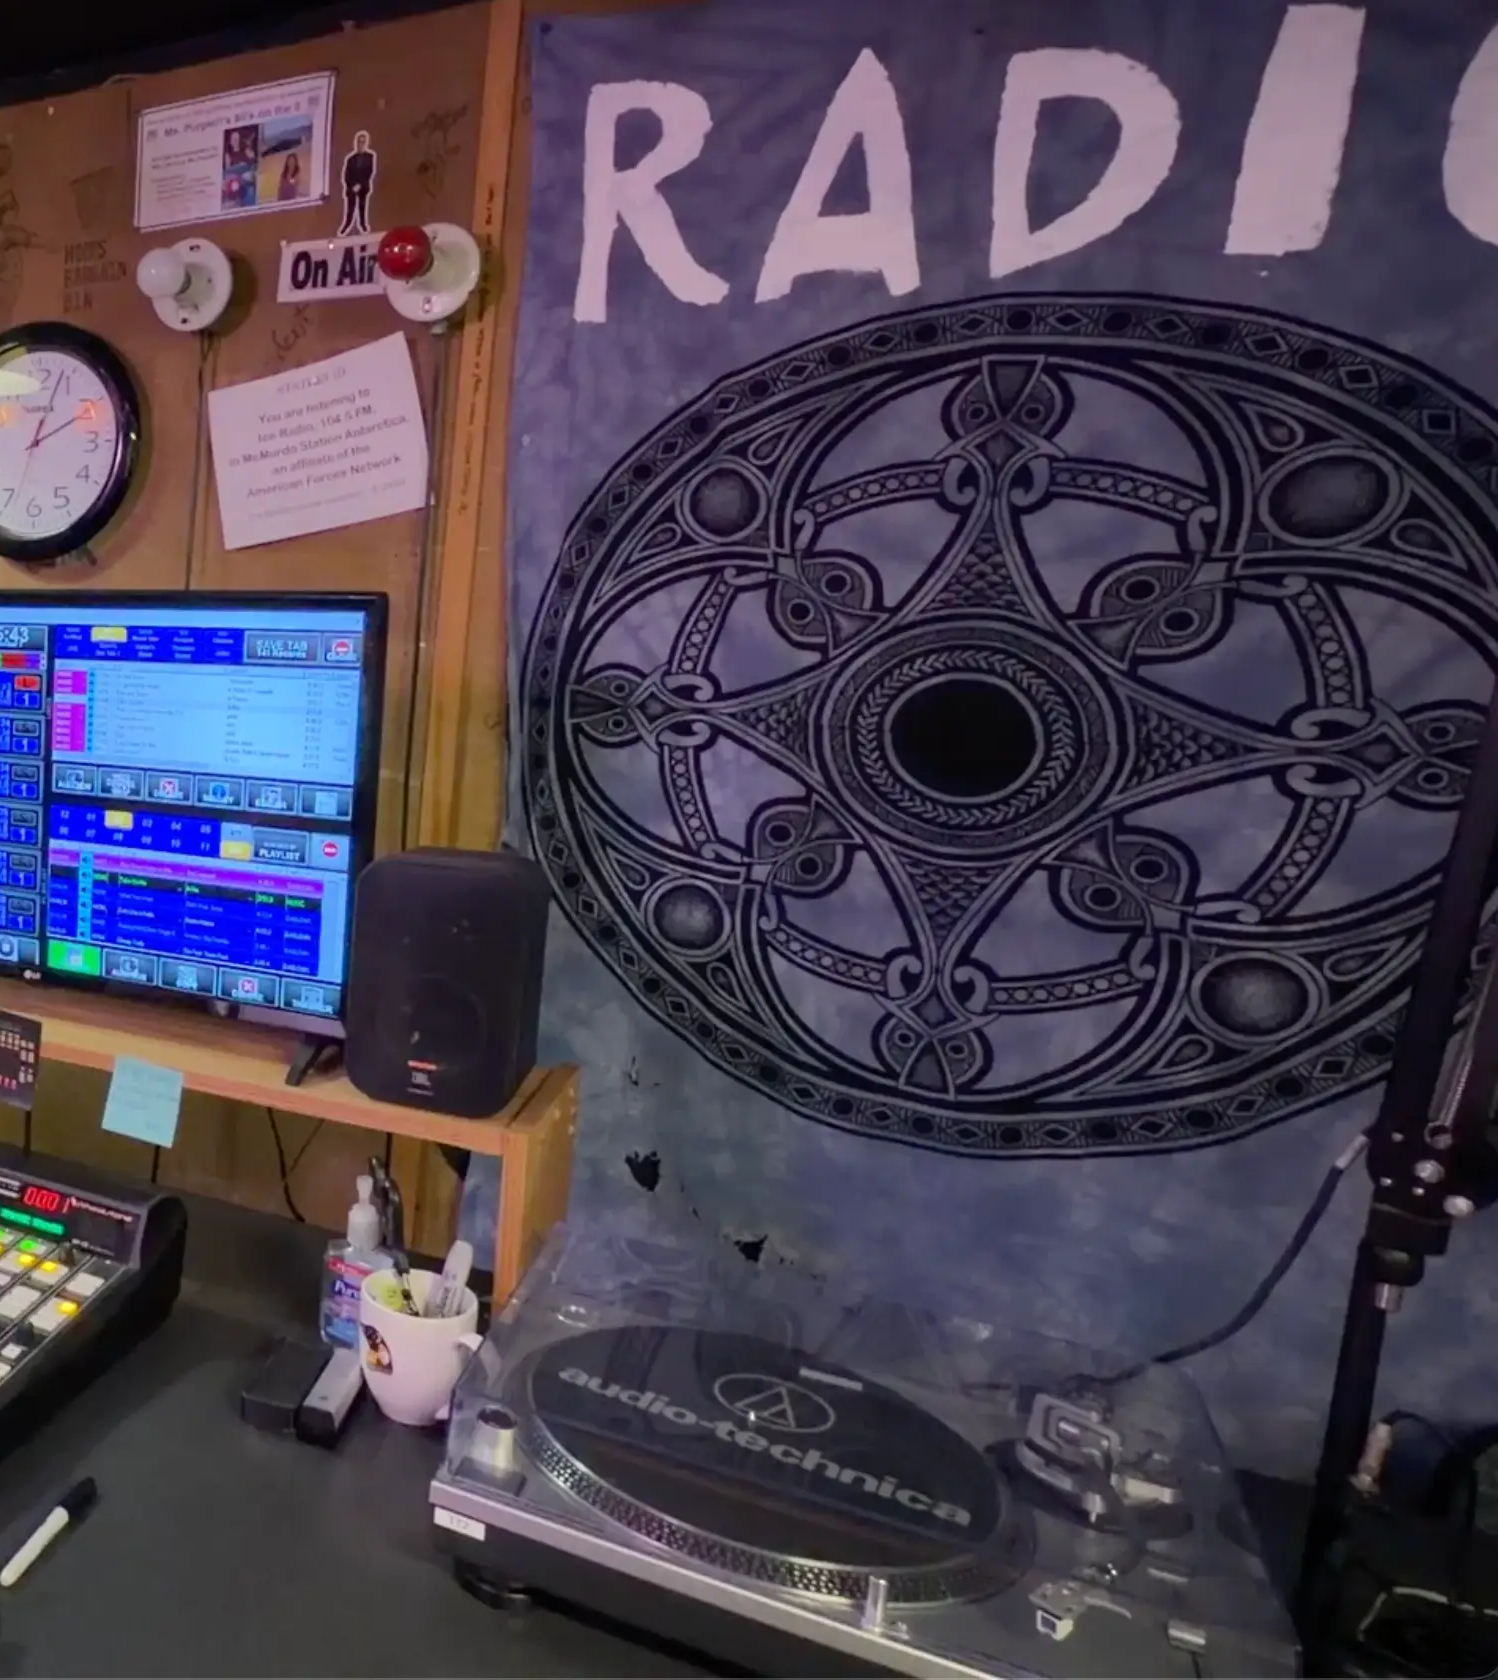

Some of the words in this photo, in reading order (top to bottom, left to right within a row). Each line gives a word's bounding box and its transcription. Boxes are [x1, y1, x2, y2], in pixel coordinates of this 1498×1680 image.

[290, 249, 329, 291] On
[335, 244, 379, 287] Air
[65, 374, 71, 397] 1
[258, 412, 282, 425] You
[284, 407, 303, 420] are
[306, 393, 356, 415] listening
[359, 388, 370, 398] to
[84, 431, 99, 454] 3
[229, 456, 240, 467] in
[242, 446, 297, 464] McMurdo
[300, 436, 343, 452] Station
[271, 466, 287, 476] an
[336, 450, 349, 461] of
[350, 444, 370, 457] the
[76, 465, 90, 483] 4
[246, 480, 303, 499] American
[305, 470, 347, 488] Forces
[350, 453, 401, 477] Network
[1, 488, 15, 508] 7
[26, 496, 42, 518] 6
[53, 487, 70, 510] 5
[257, 848, 299, 862] PLAYLIST
[558, 1367, 976, 1535] audio-technica
